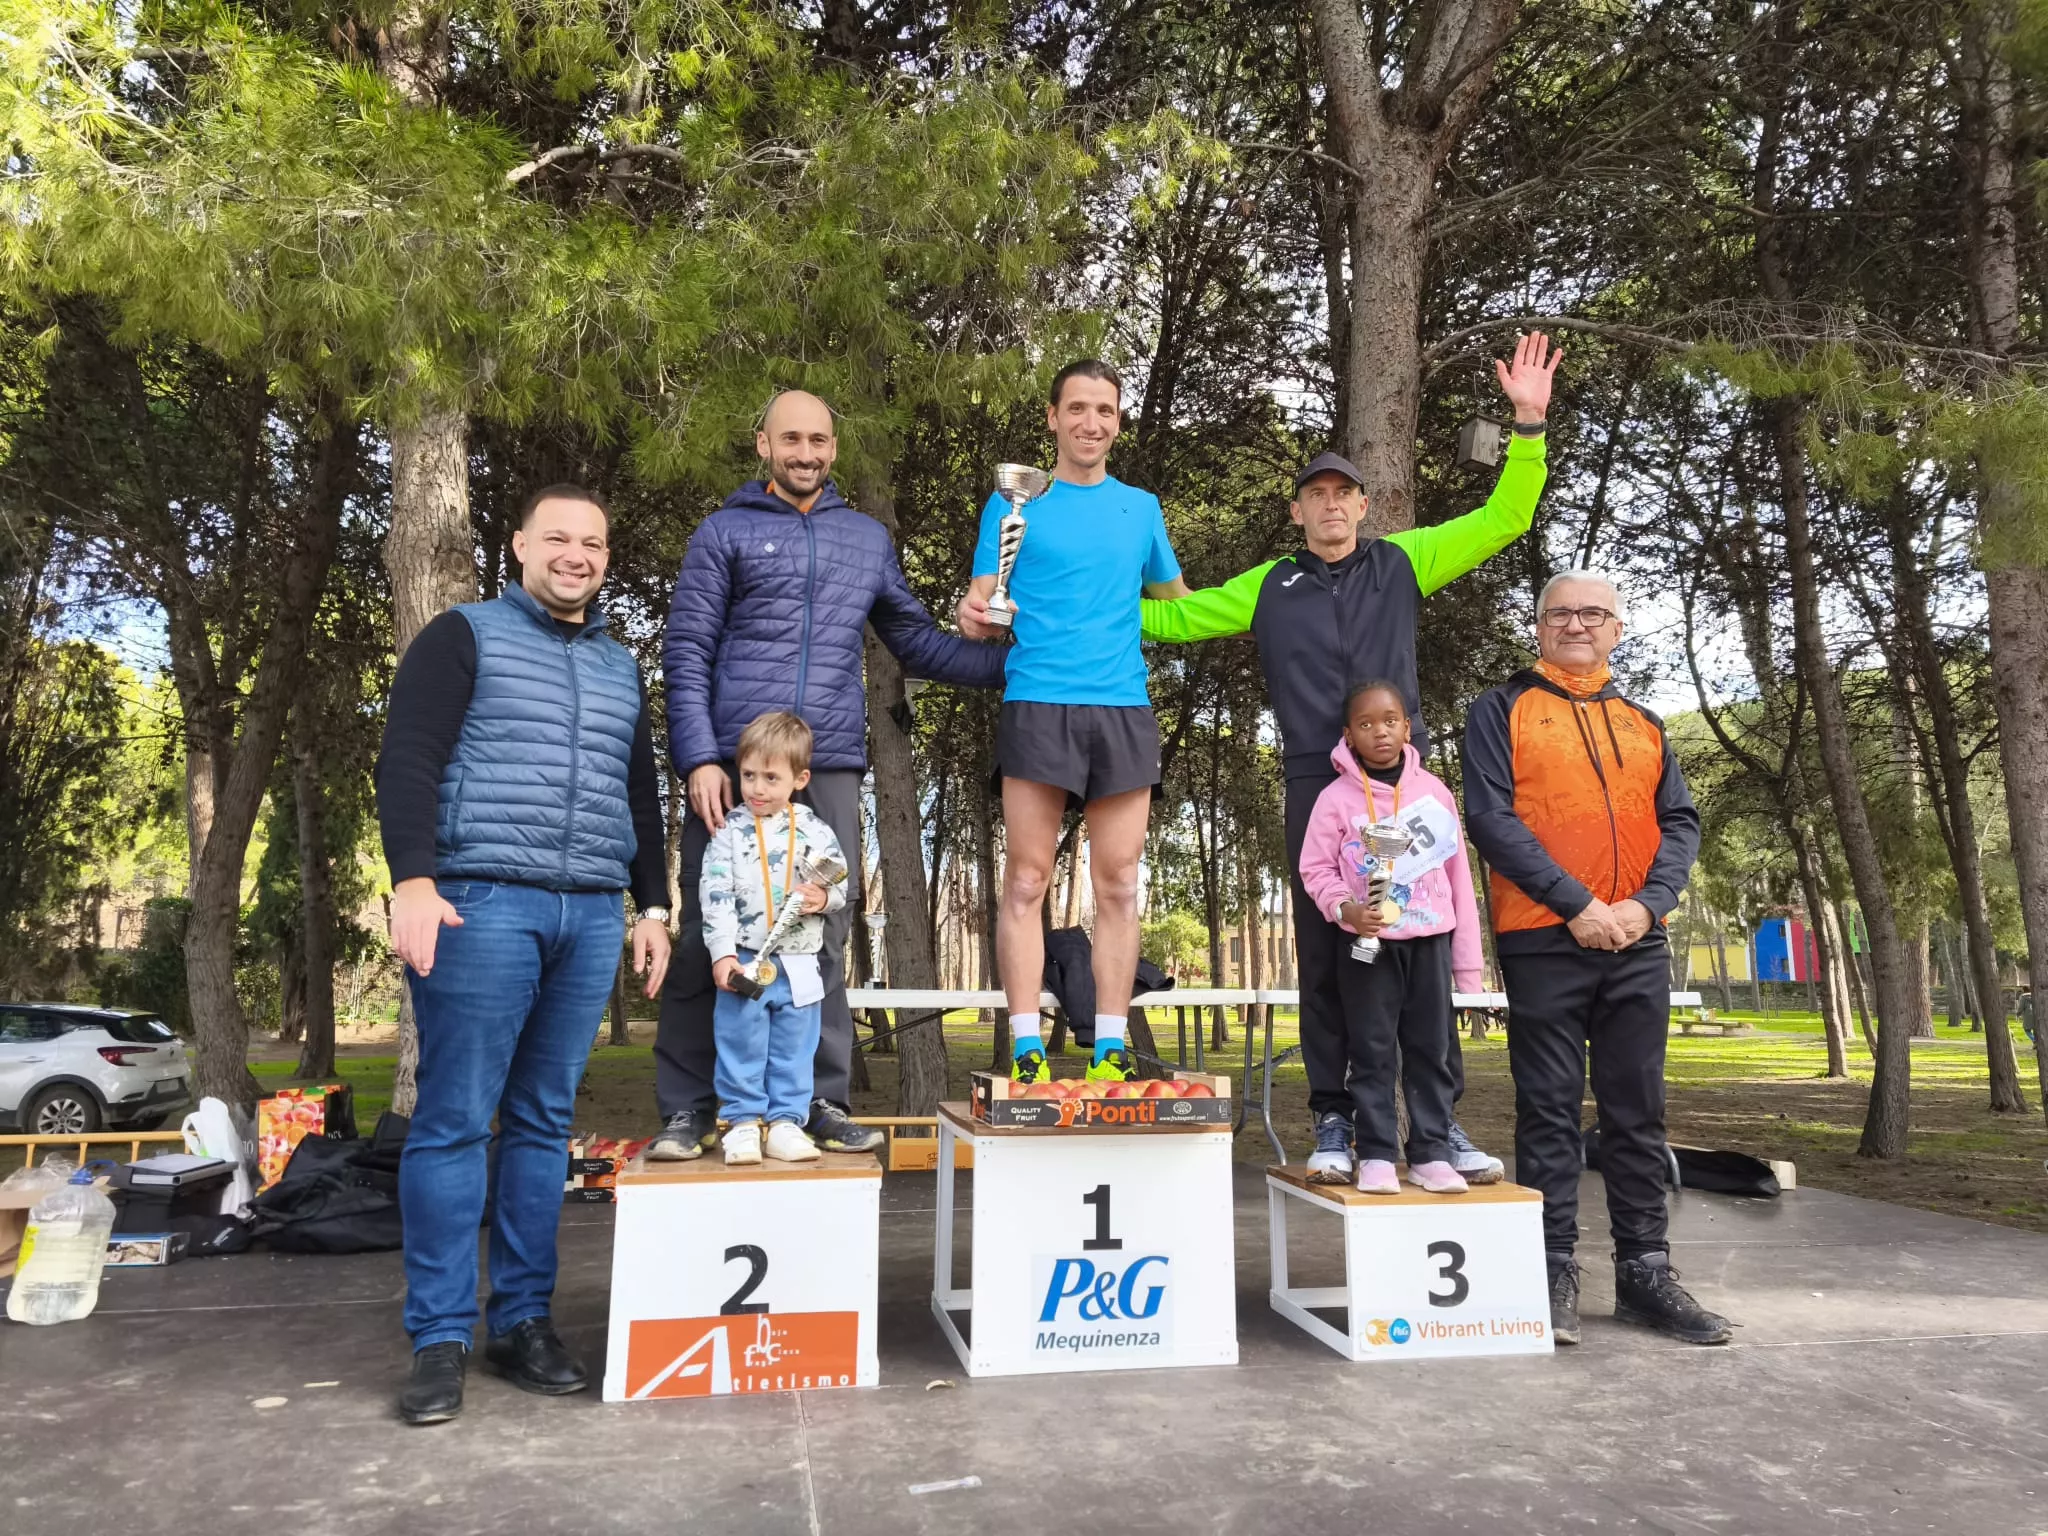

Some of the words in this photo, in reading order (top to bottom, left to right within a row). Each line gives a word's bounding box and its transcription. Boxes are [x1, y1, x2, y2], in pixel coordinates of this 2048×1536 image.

[1090, 1101, 1156, 1123] Ponti
[1083, 1184, 1122, 1250] 1
[720, 1244, 769, 1315] 2
[1037, 1255, 1170, 1323] P&G
[1427, 1240, 1470, 1307] 3
[1036, 1330, 1160, 1353] Mequinenza
[1417, 1320, 1485, 1339] Vibrant
[1491, 1316, 1545, 1338] Living
